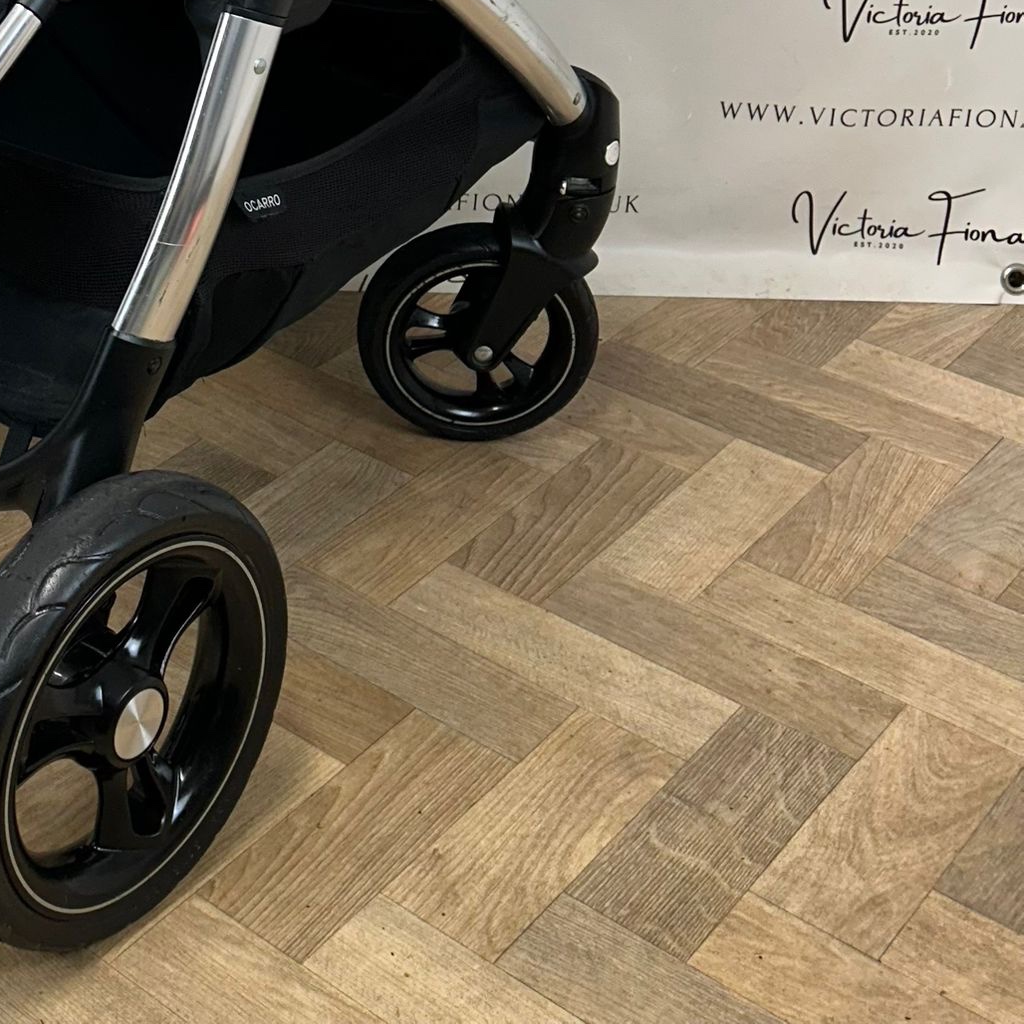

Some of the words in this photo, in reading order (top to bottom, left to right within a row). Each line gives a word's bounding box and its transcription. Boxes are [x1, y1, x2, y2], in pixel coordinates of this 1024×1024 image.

[244, 194, 281, 212] OCARRO
[792, 191, 926, 255] Victoria
[928, 188, 1024, 265] Fiona
